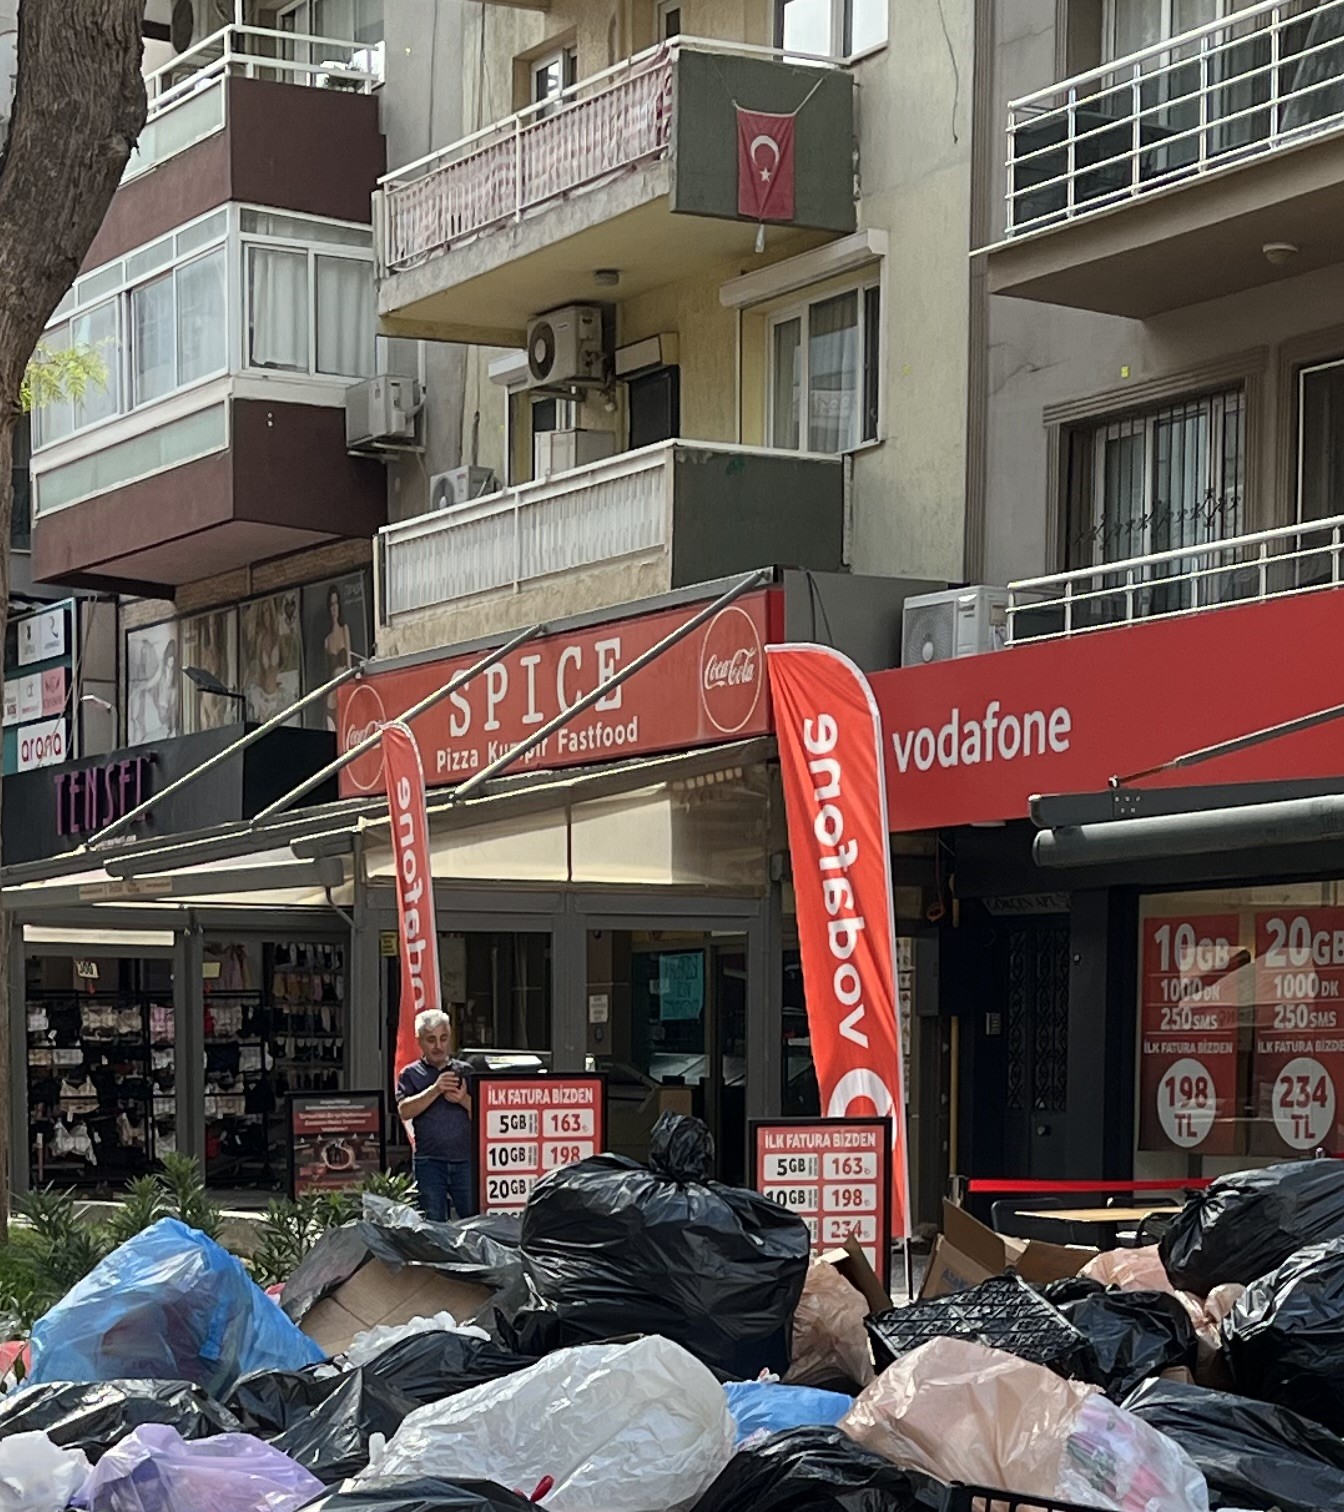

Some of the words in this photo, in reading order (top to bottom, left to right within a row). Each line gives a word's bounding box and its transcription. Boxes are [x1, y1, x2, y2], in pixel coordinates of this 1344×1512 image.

[449, 637, 622, 737] SPICE
[436, 749, 479, 773] Pizza
[557, 716, 638, 754] Fastfood
[892, 700, 1072, 773] vodafone
[488, 1085, 506, 1105] İLK
[508, 1088, 551, 1105] FATURA
[552, 1085, 593, 1104] BİZDEN
[1165, 1075, 1209, 1110] 198
[1279, 1075, 1328, 1109] 234
[765, 1130, 784, 1149] İLK
[787, 1133, 832, 1149] FATURA
[833, 1131, 876, 1147] BİZDEN
[1174, 1113, 1198, 1138] TL
[1291, 1114, 1316, 1139] TL
